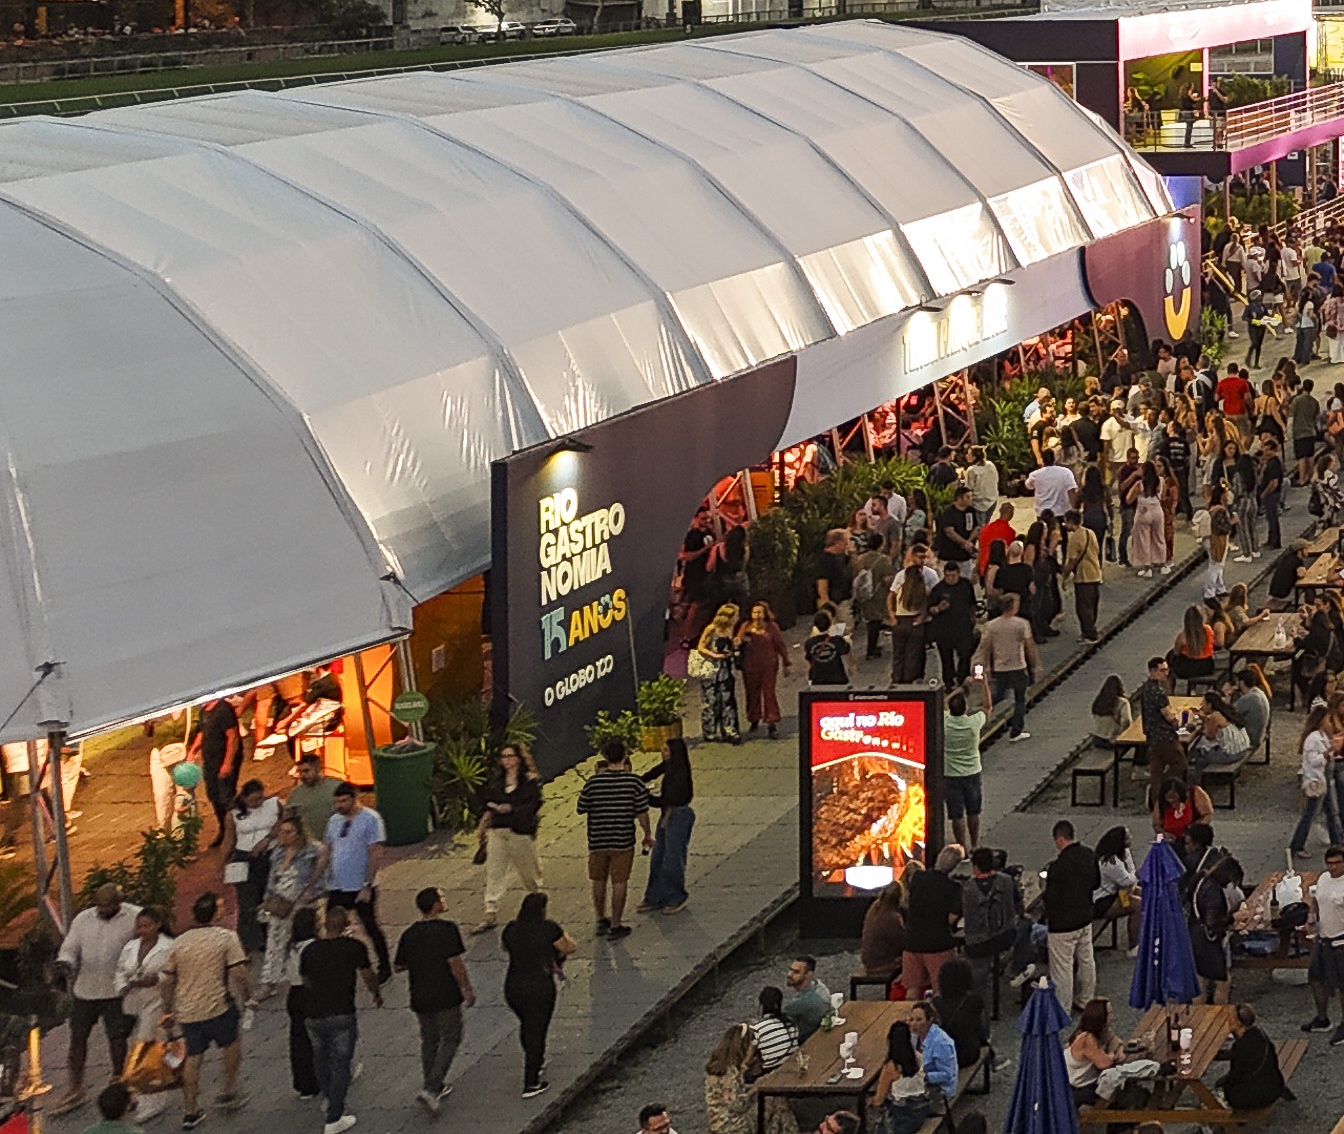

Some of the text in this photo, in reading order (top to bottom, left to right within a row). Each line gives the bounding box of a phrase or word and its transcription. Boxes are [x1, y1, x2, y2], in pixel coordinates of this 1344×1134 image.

[539, 487, 578, 534] RIO
[539, 502, 625, 569] GASTRO
[540, 542, 613, 606] NOMIA
[541, 588, 627, 661] 15 ANOS
[544, 654, 614, 707] O GLOBO 100
[856, 714, 877, 728] no
[877, 711, 905, 727] Rio
